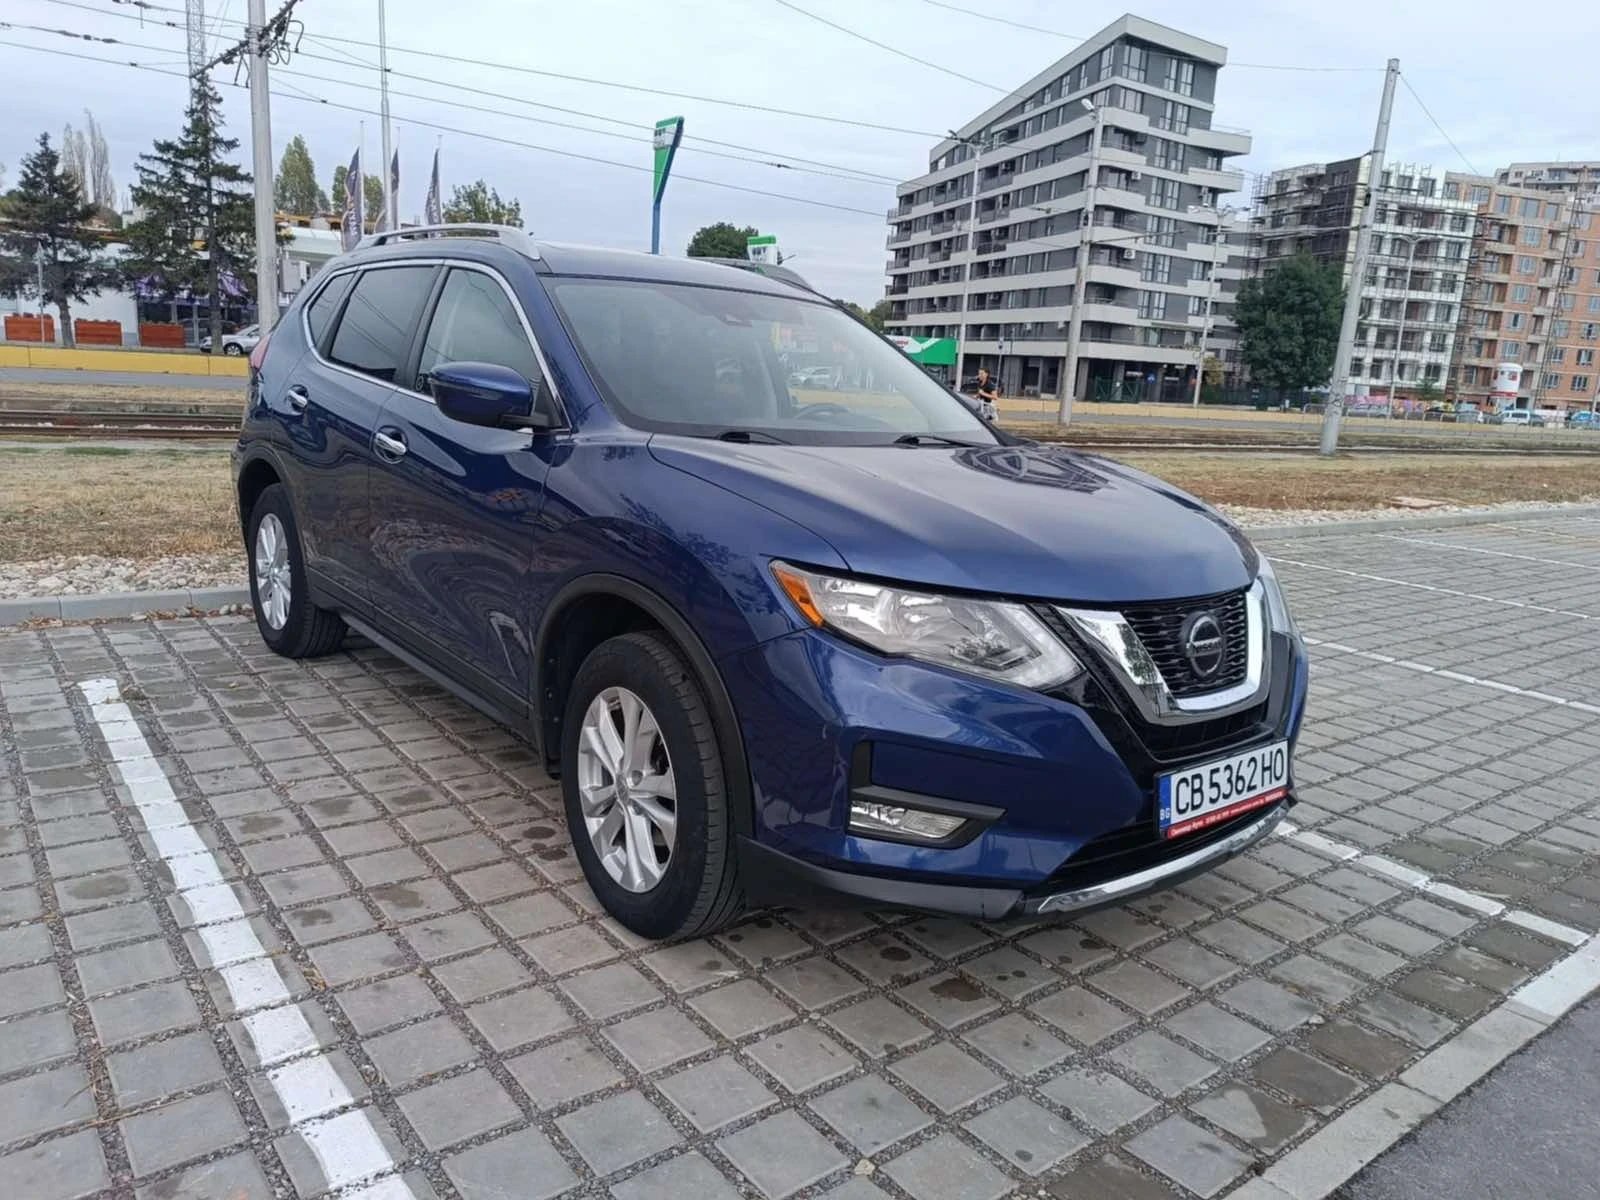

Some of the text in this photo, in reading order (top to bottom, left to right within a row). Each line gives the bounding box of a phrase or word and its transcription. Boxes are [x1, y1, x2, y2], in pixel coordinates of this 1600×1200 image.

[1175, 773, 1204, 815] CB
[1208, 757, 1257, 804] 5362
[1261, 748, 1285, 787] HO
[1160, 808, 1170, 820] BG
